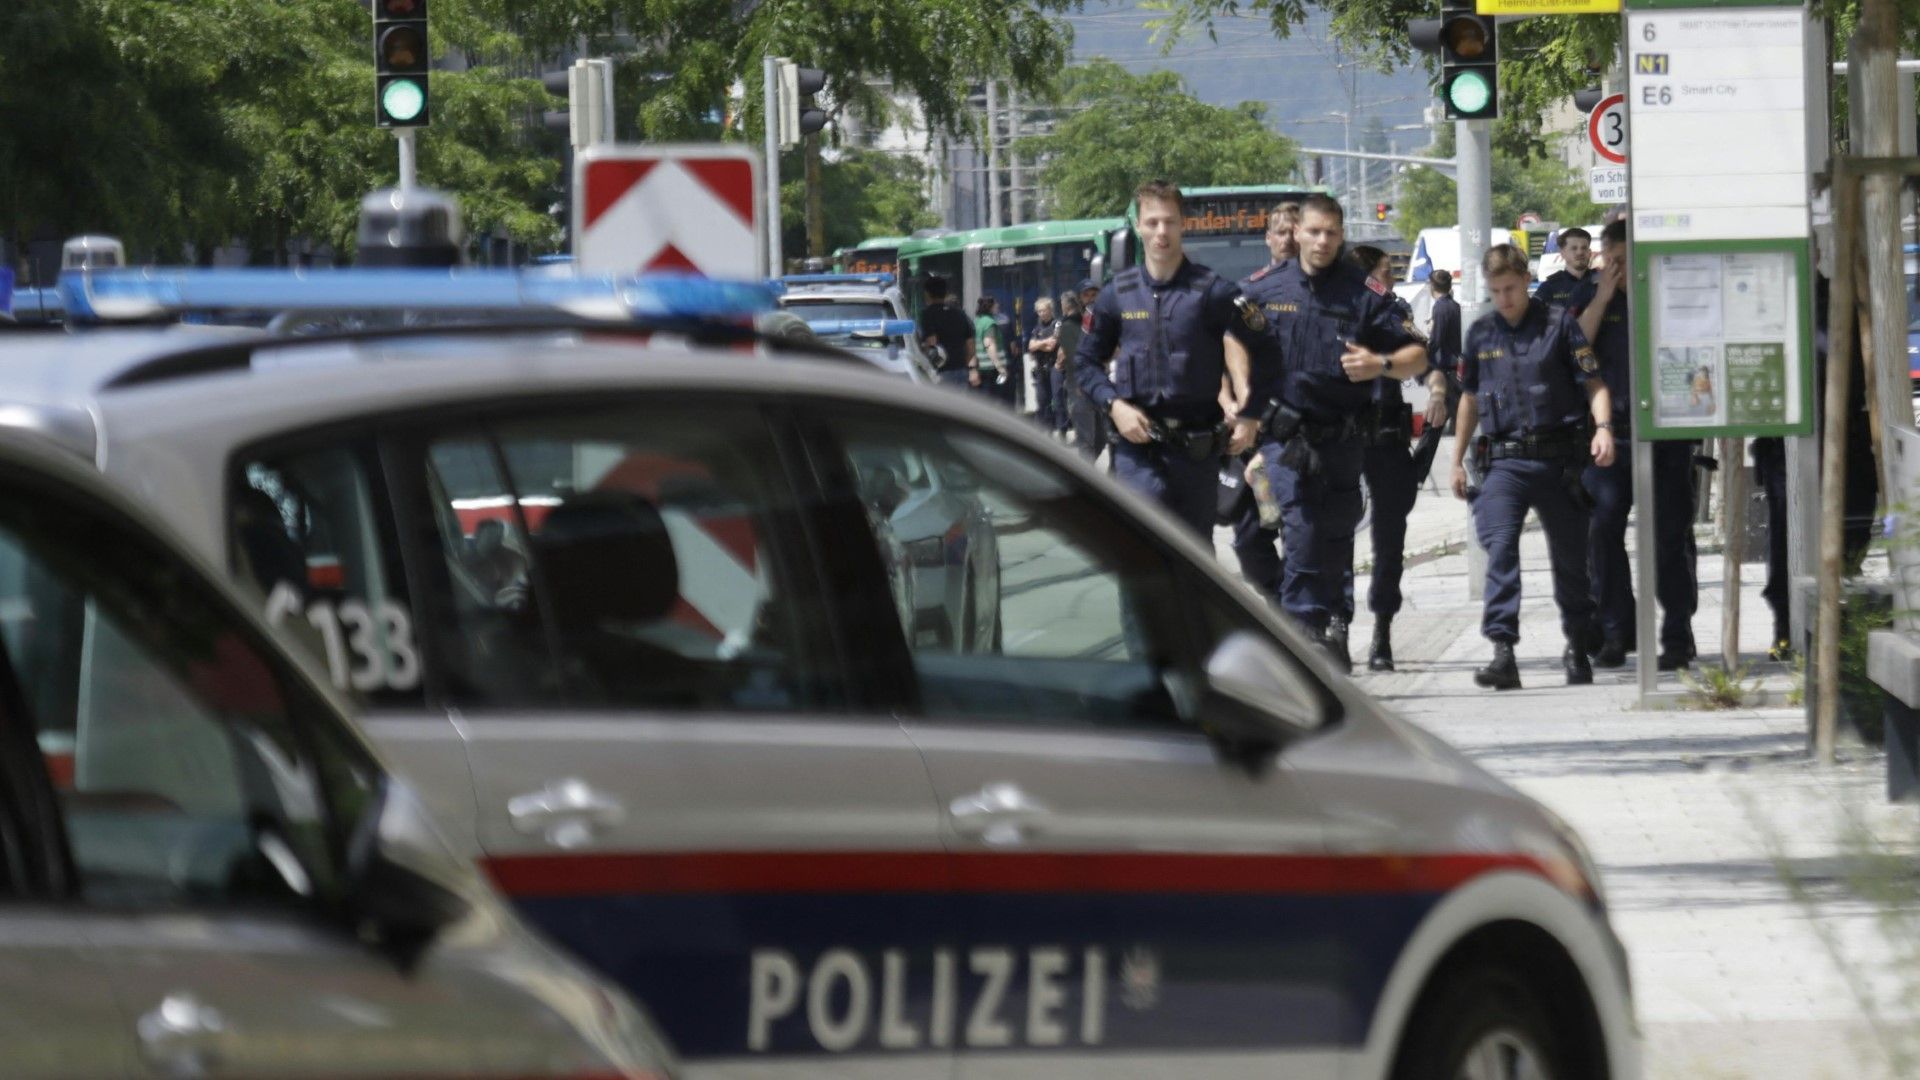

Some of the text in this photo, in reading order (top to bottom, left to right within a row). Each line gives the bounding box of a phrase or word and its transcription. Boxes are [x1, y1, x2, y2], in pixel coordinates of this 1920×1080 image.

[1643, 22, 1657, 42] 6
[1638, 55, 1666, 74] N1
[1643, 86, 1672, 106] E6
[1681, 85, 1737, 96] Smart City
[1606, 112, 1623, 146] 3
[1593, 174, 1604, 183] an
[1598, 189, 1614, 198] von
[1182, 208, 1267, 231] onderfah
[1121, 311, 1150, 320] POLIZEI
[1266, 303, 1297, 312] POLIZEI
[747, 947, 1107, 1052] POLIZEI
